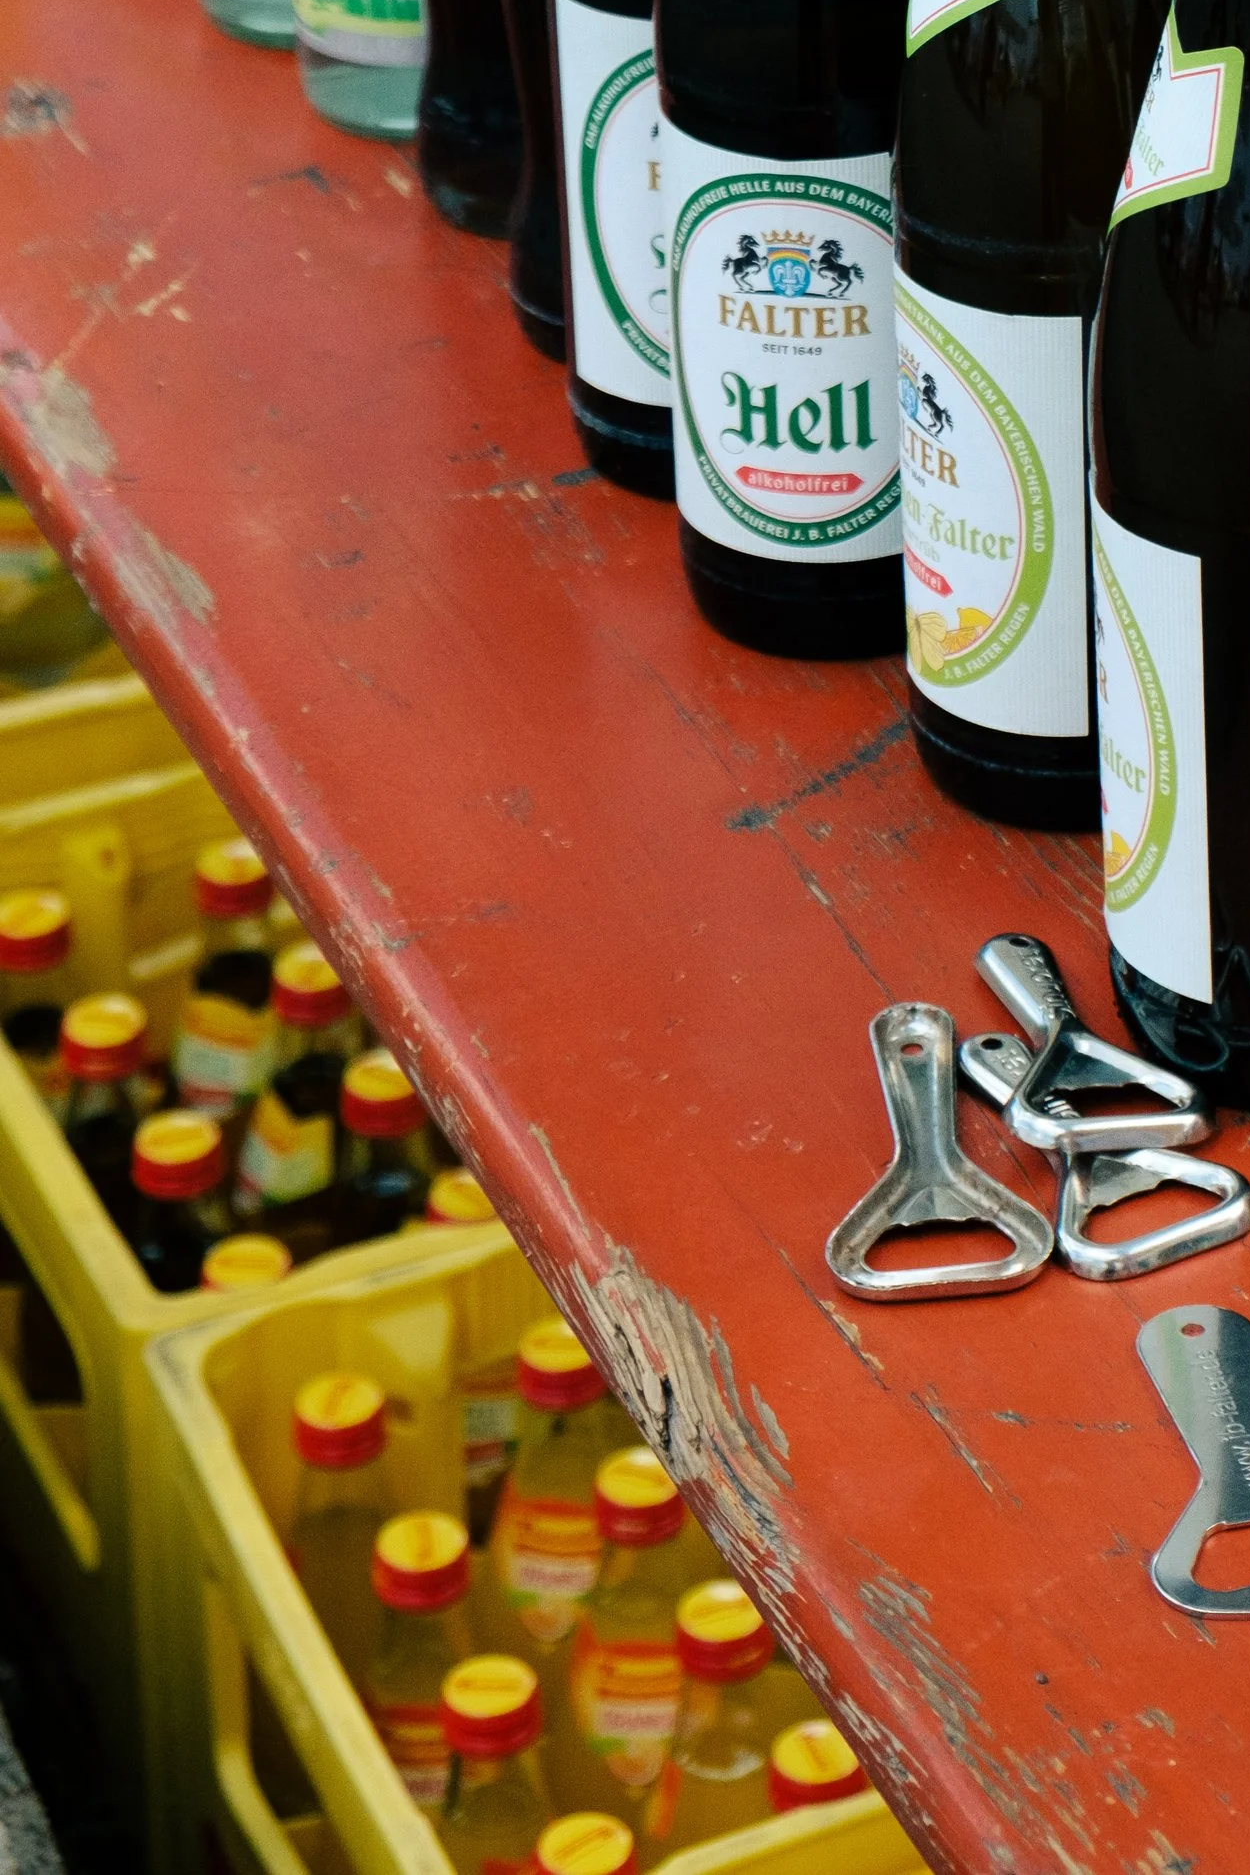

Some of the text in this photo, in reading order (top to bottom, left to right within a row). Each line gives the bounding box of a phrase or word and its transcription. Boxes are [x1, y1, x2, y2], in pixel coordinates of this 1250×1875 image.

[727, 180, 772, 197] HELLE
[774, 181, 806, 194] AUS
[808, 183, 845, 202] DEM
[718, 293, 873, 340] FALTER
[761, 342, 823, 357] SEIT 1649
[719, 370, 879, 456] Hell
[944, 342, 972, 372] AUS
[967, 369, 998, 405] DEM
[995, 403, 1045, 506] BAYERISCHEN
[1031, 508, 1047, 554] WALD
[699, 455, 790, 540] PRIVATBRAUEREI
[826, 509, 878, 539] FALTER
[747, 472, 849, 493] alkoholfrei
[965, 642, 1002, 674] FALTER
[997, 603, 1031, 646] REGEN
[1158, 748, 1171, 797] WALD
